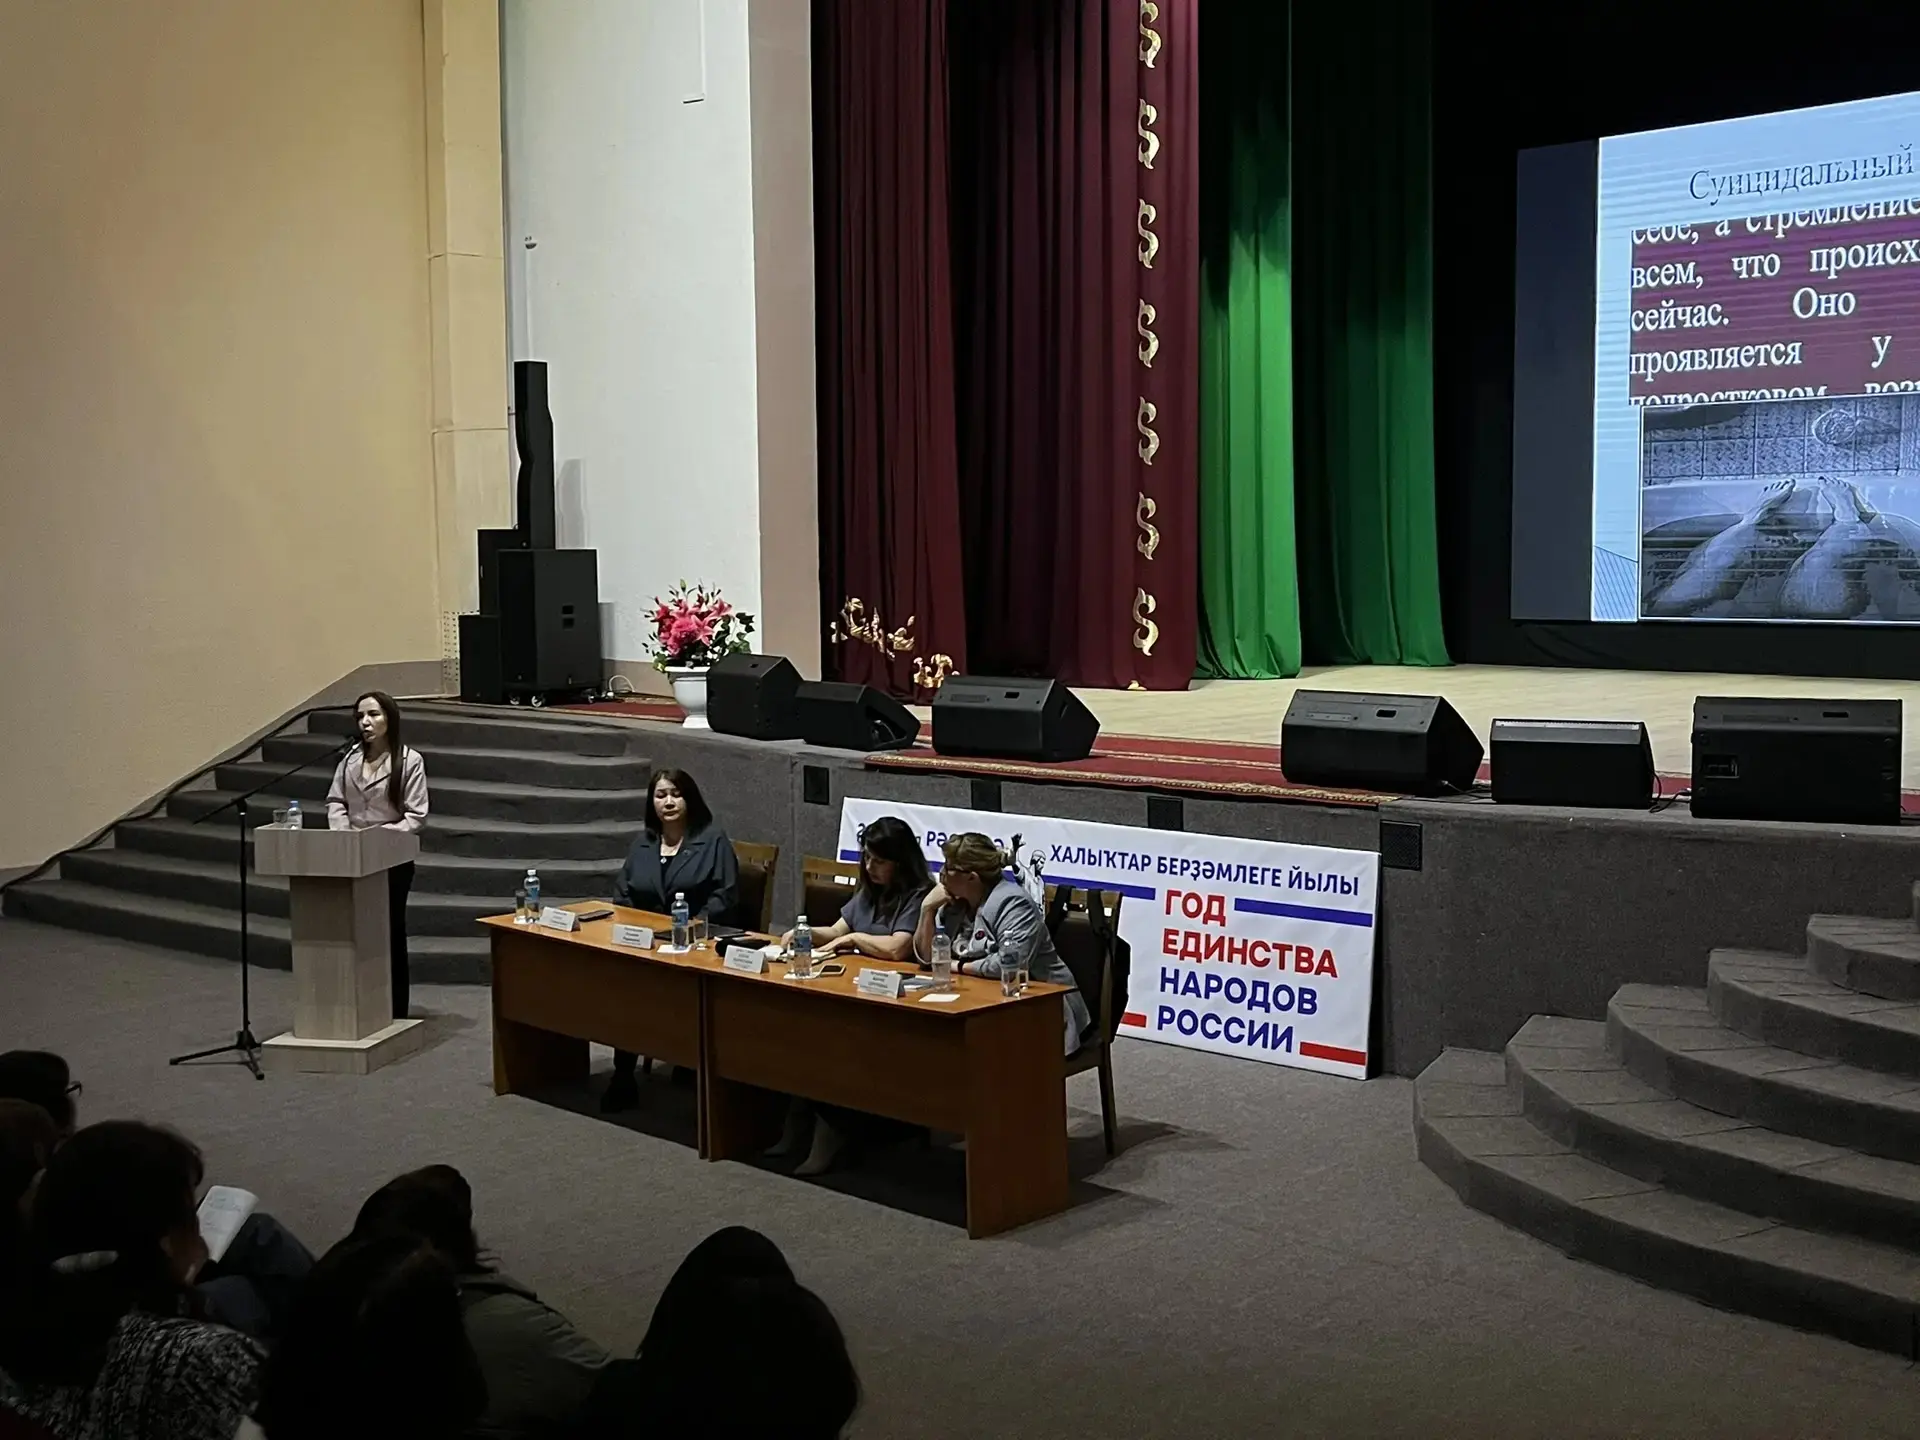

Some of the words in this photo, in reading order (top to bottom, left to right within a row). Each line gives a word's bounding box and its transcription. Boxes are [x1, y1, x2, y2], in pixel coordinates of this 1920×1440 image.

[1689, 143, 1914, 206] Суицидальный
[1714, 218, 1731, 237] а
[1632, 261, 1704, 289] всем,
[1731, 253, 1781, 279] что
[1808, 239, 1920, 280] происх
[1631, 299, 1730, 332] сейчас.
[1792, 287, 1856, 319] Оно
[1629, 342, 1802, 382] проявляется
[1871, 335, 1892, 368] у
[1050, 844, 1152, 872] ХАЛЫҠТАР
[1157, 856, 1281, 887] БЕРҘӘМЛЕГЕ
[1288, 866, 1359, 896] ЙЫЛЫ
[1165, 889, 1226, 926] ГОД
[1162, 929, 1338, 977] ЕДИНСТВА
[1160, 966, 1318, 1016] НАРОДОВ
[1157, 1005, 1294, 1053] РОССИИ
